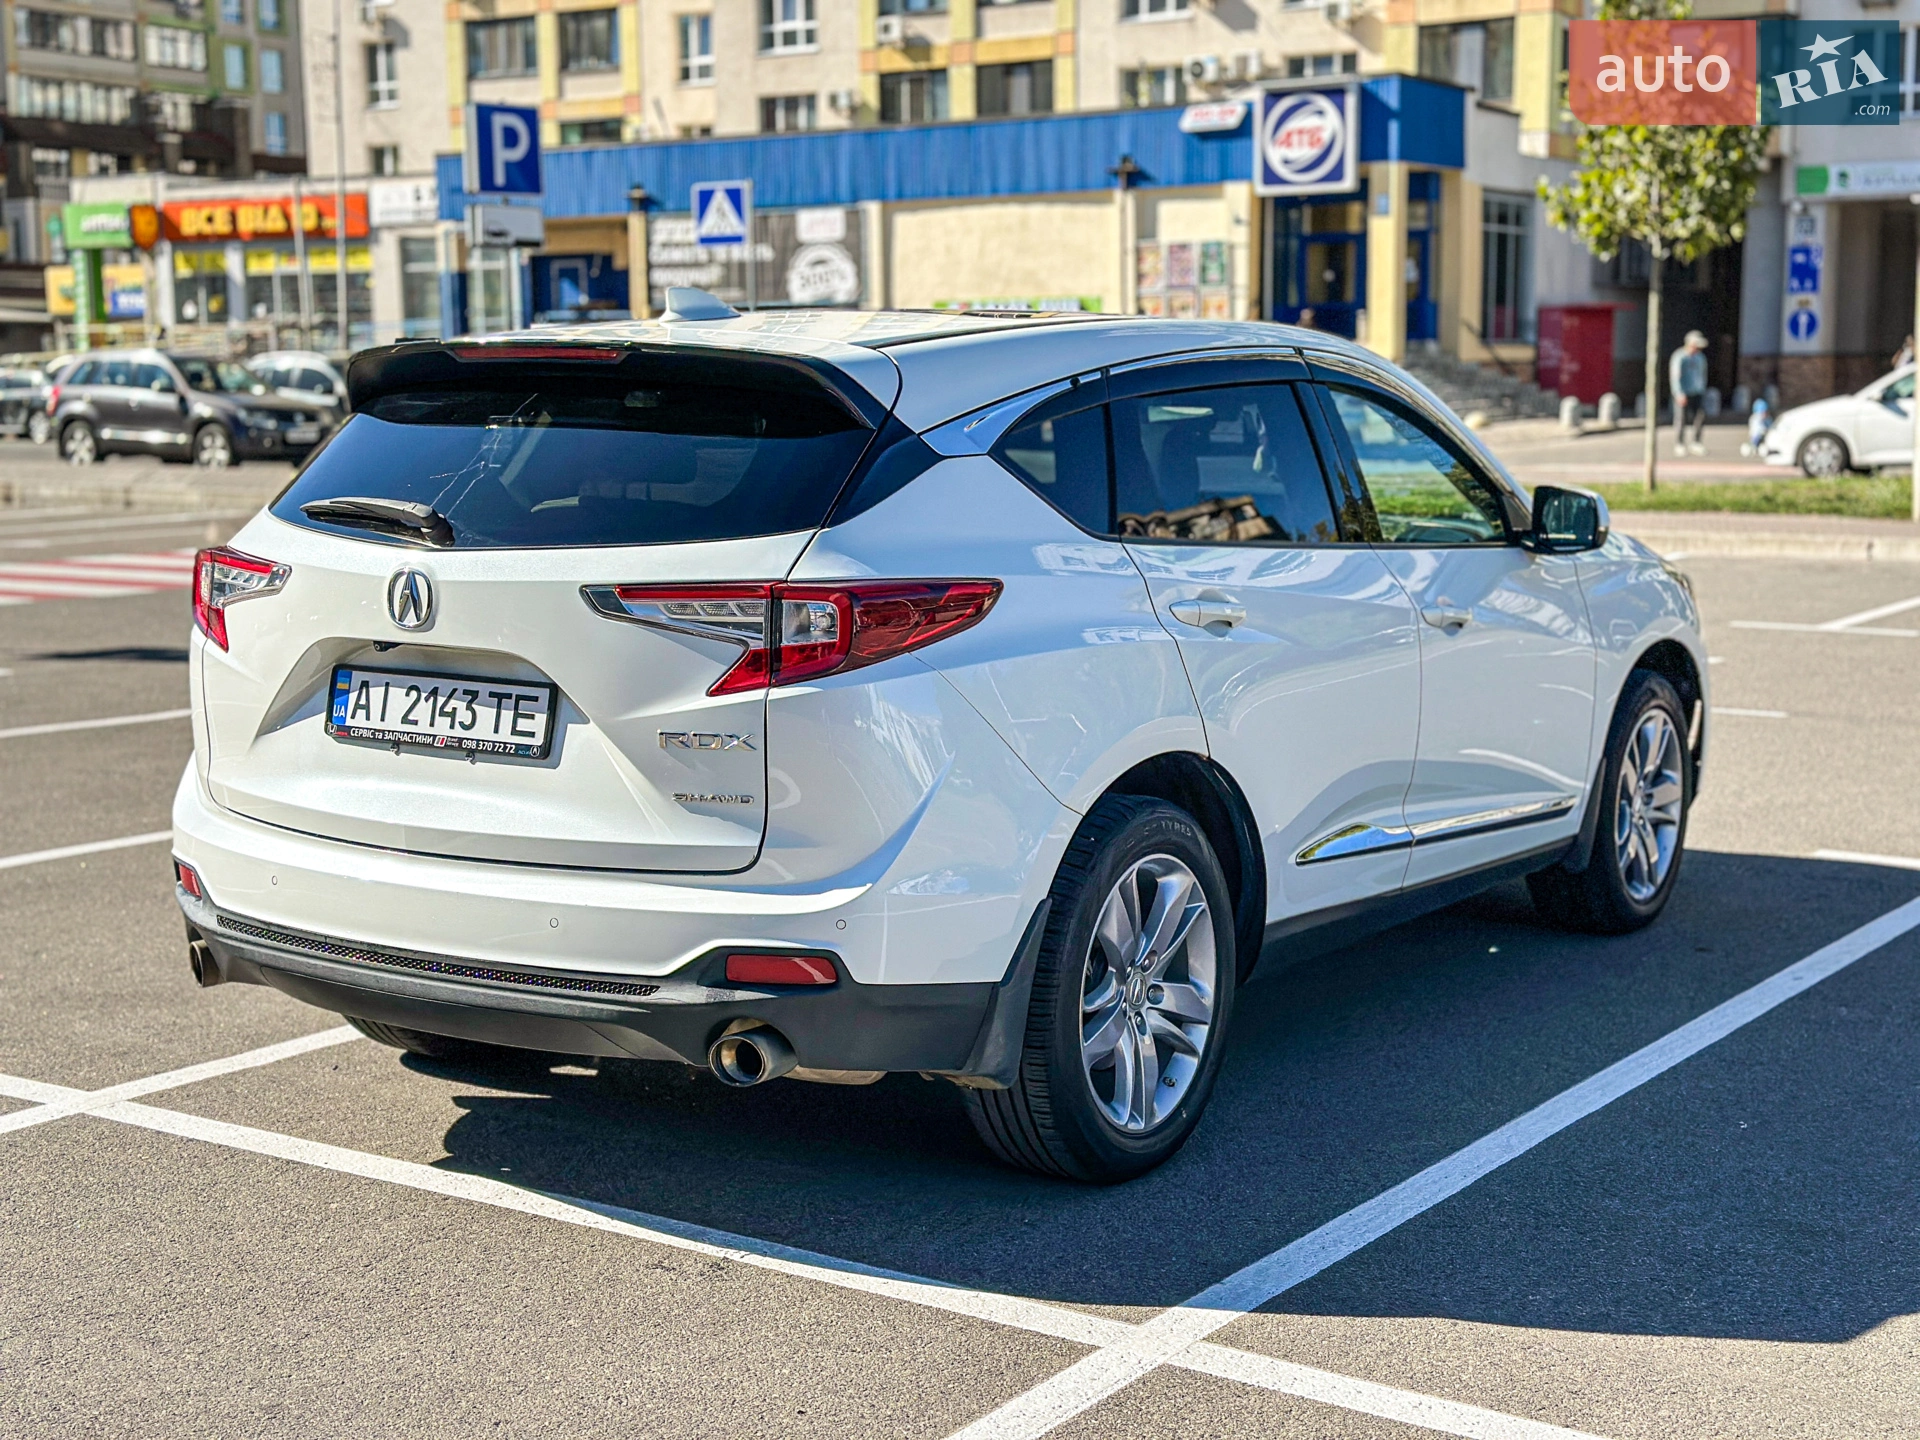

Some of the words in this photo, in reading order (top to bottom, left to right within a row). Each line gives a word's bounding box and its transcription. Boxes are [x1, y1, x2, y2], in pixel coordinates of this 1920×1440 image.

[490, 110, 531, 189] P
[180, 205, 233, 236] ВСЕ
[333, 704, 346, 718] UA
[350, 680, 390, 722] AI
[400, 684, 480, 731] 2143
[488, 690, 539, 738] TE
[350, 727, 374, 739] СЕРВІС
[375, 732, 383, 740] та
[383, 730, 434, 745] ЗАПЧАСТИНИ
[462, 739, 477, 749] 098
[478, 741, 493, 751] 370
[494, 743, 504, 752] 72
[505, 744, 516, 754] 72
[657, 729, 757, 751] RDX
